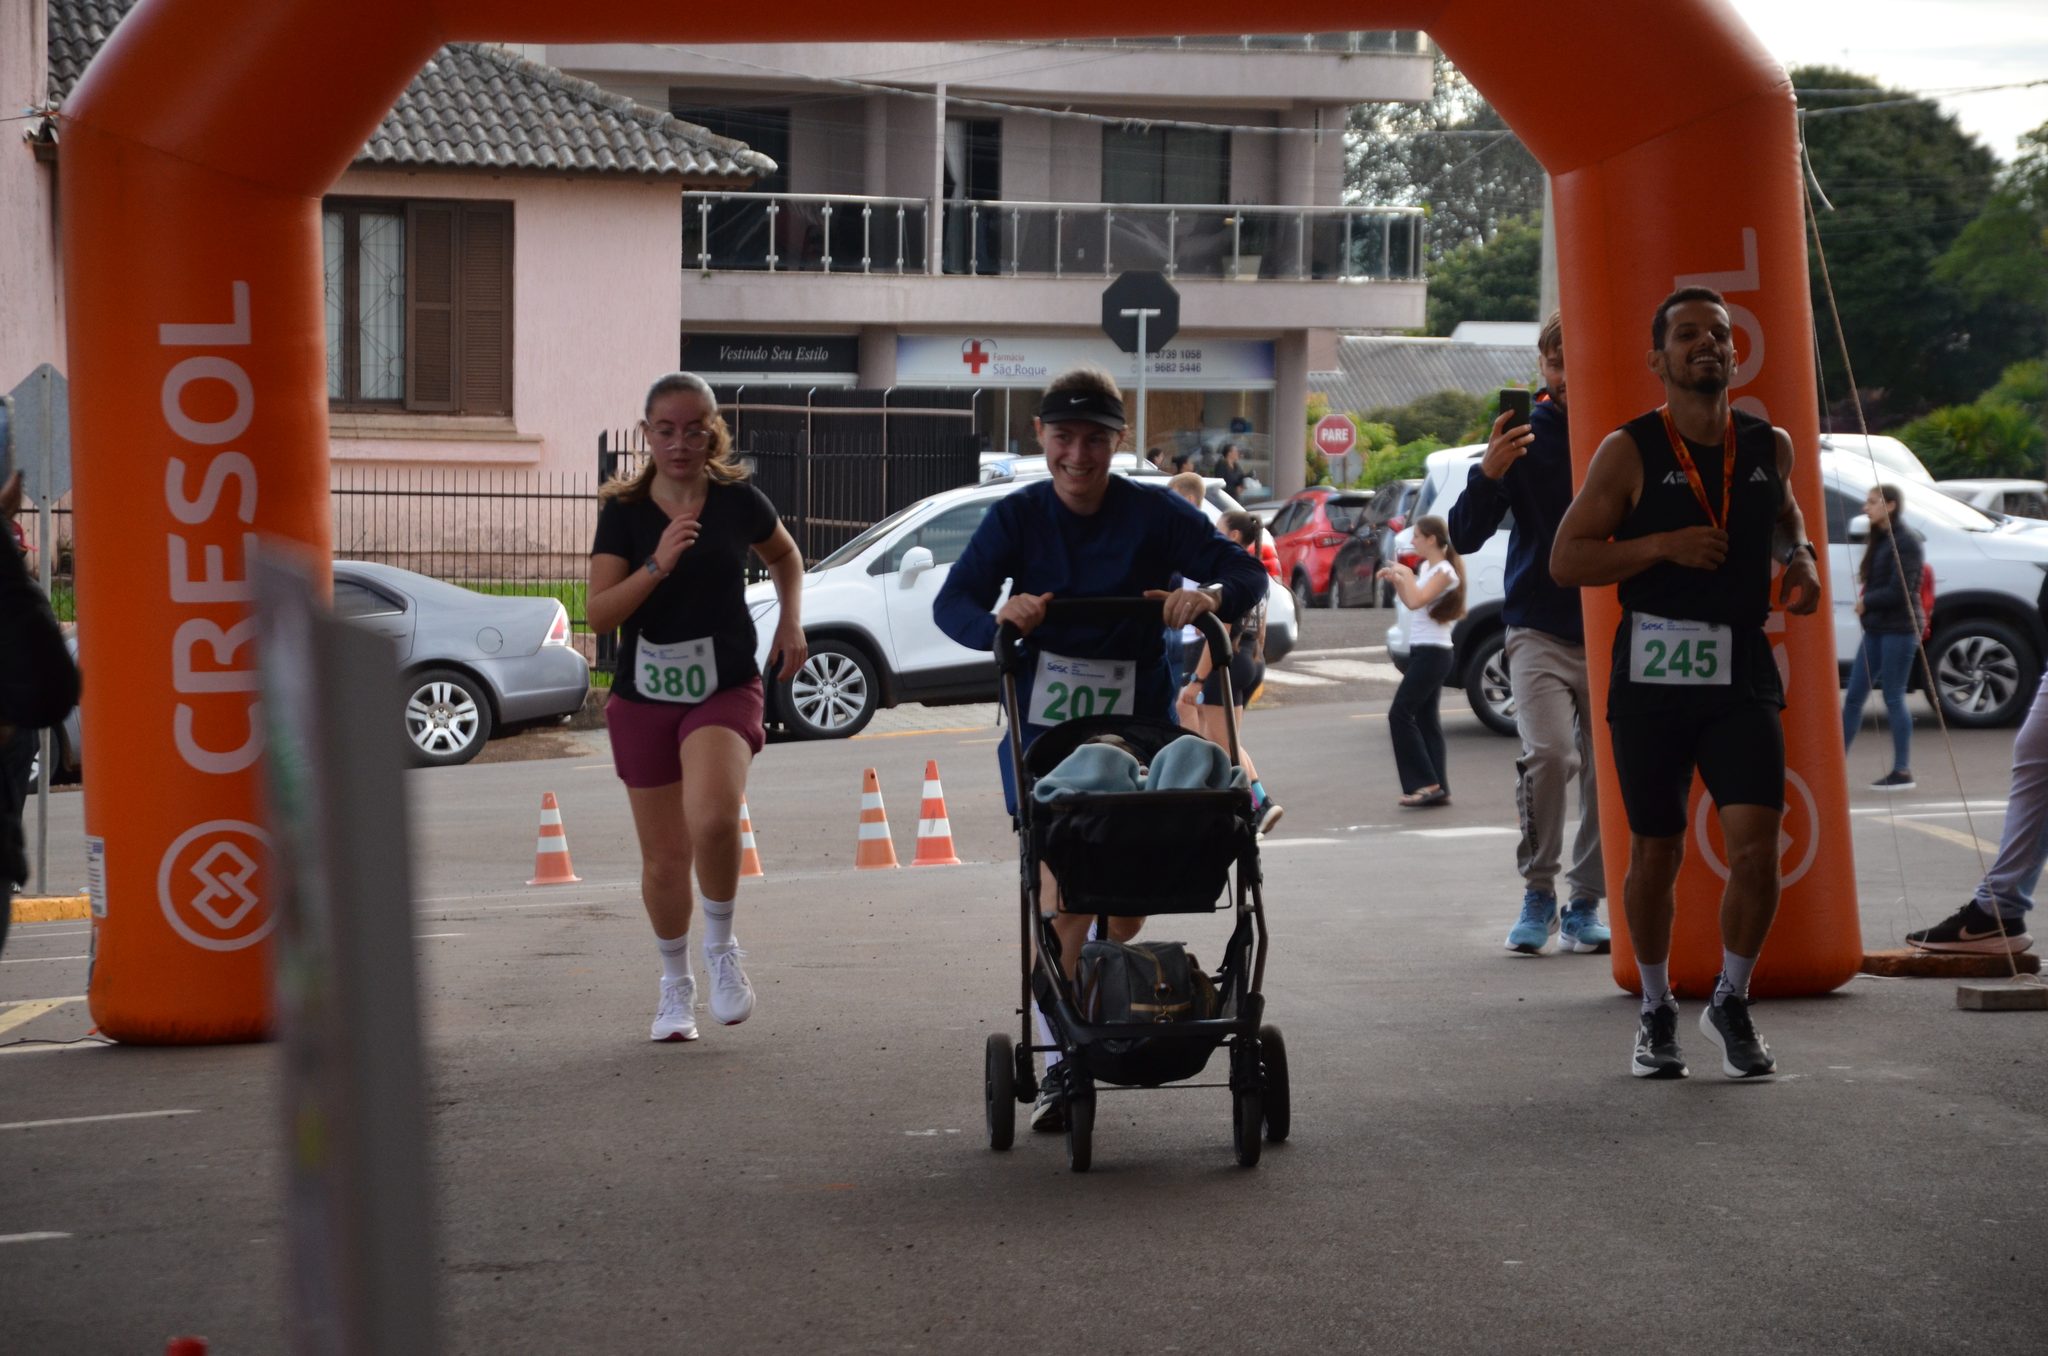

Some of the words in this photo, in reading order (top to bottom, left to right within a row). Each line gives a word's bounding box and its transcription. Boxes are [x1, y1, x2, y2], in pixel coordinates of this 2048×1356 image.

[719, 345, 768, 360] Vestindo
[771, 345, 792, 360] Seu
[796, 346, 829, 361] Estilo
[993, 352, 1025, 362] Farmácia
[993, 363, 1012, 375] São
[1014, 364, 1047, 377] Roque
[1322, 428, 1349, 441] PARE
[159, 280, 266, 774] CRESOL
[1643, 639, 1718, 678] 245
[643, 663, 706, 698] 380
[1042, 681, 1121, 721] 207
